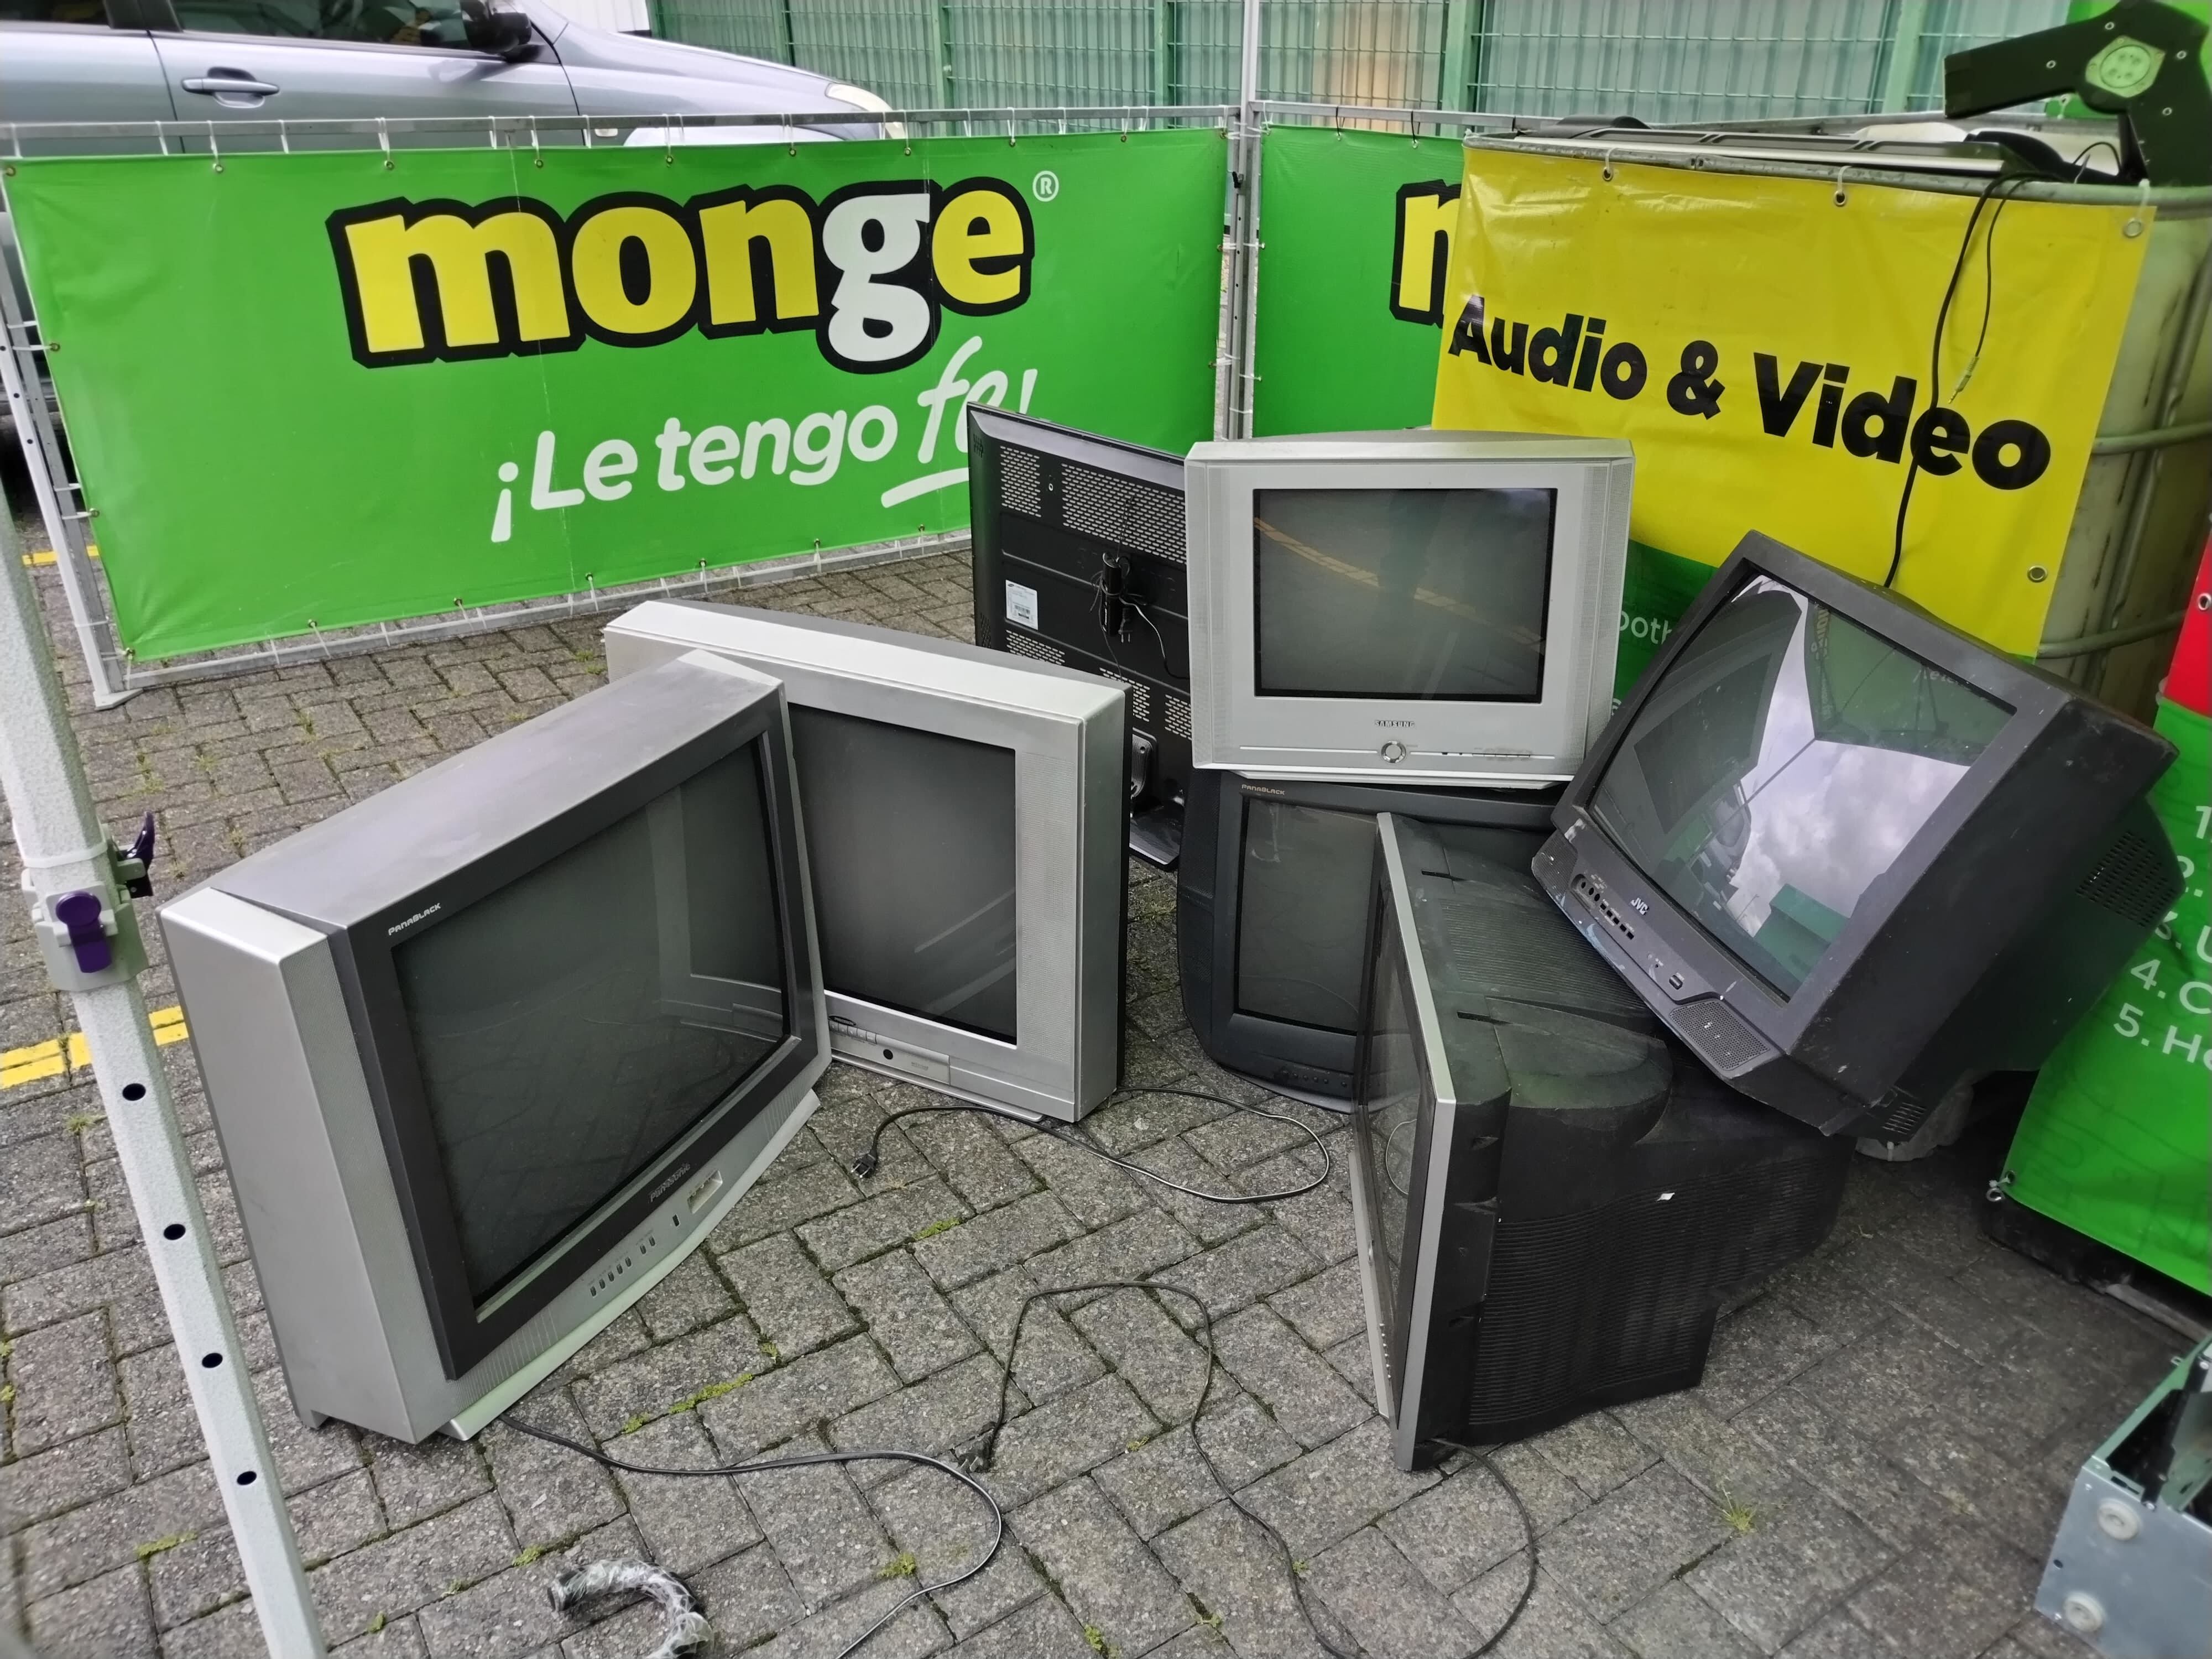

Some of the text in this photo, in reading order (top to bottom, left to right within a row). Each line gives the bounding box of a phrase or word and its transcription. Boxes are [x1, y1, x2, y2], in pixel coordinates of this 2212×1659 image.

[326, 176, 1034, 374] monge
[1449, 295, 2051, 491] Audio & Video
[655, 405, 898, 491] tengo
[1631, 897, 1649, 916] JVC
[2130, 959, 2166, 999] 4.
[2114, 1003, 2150, 1047] 5.
